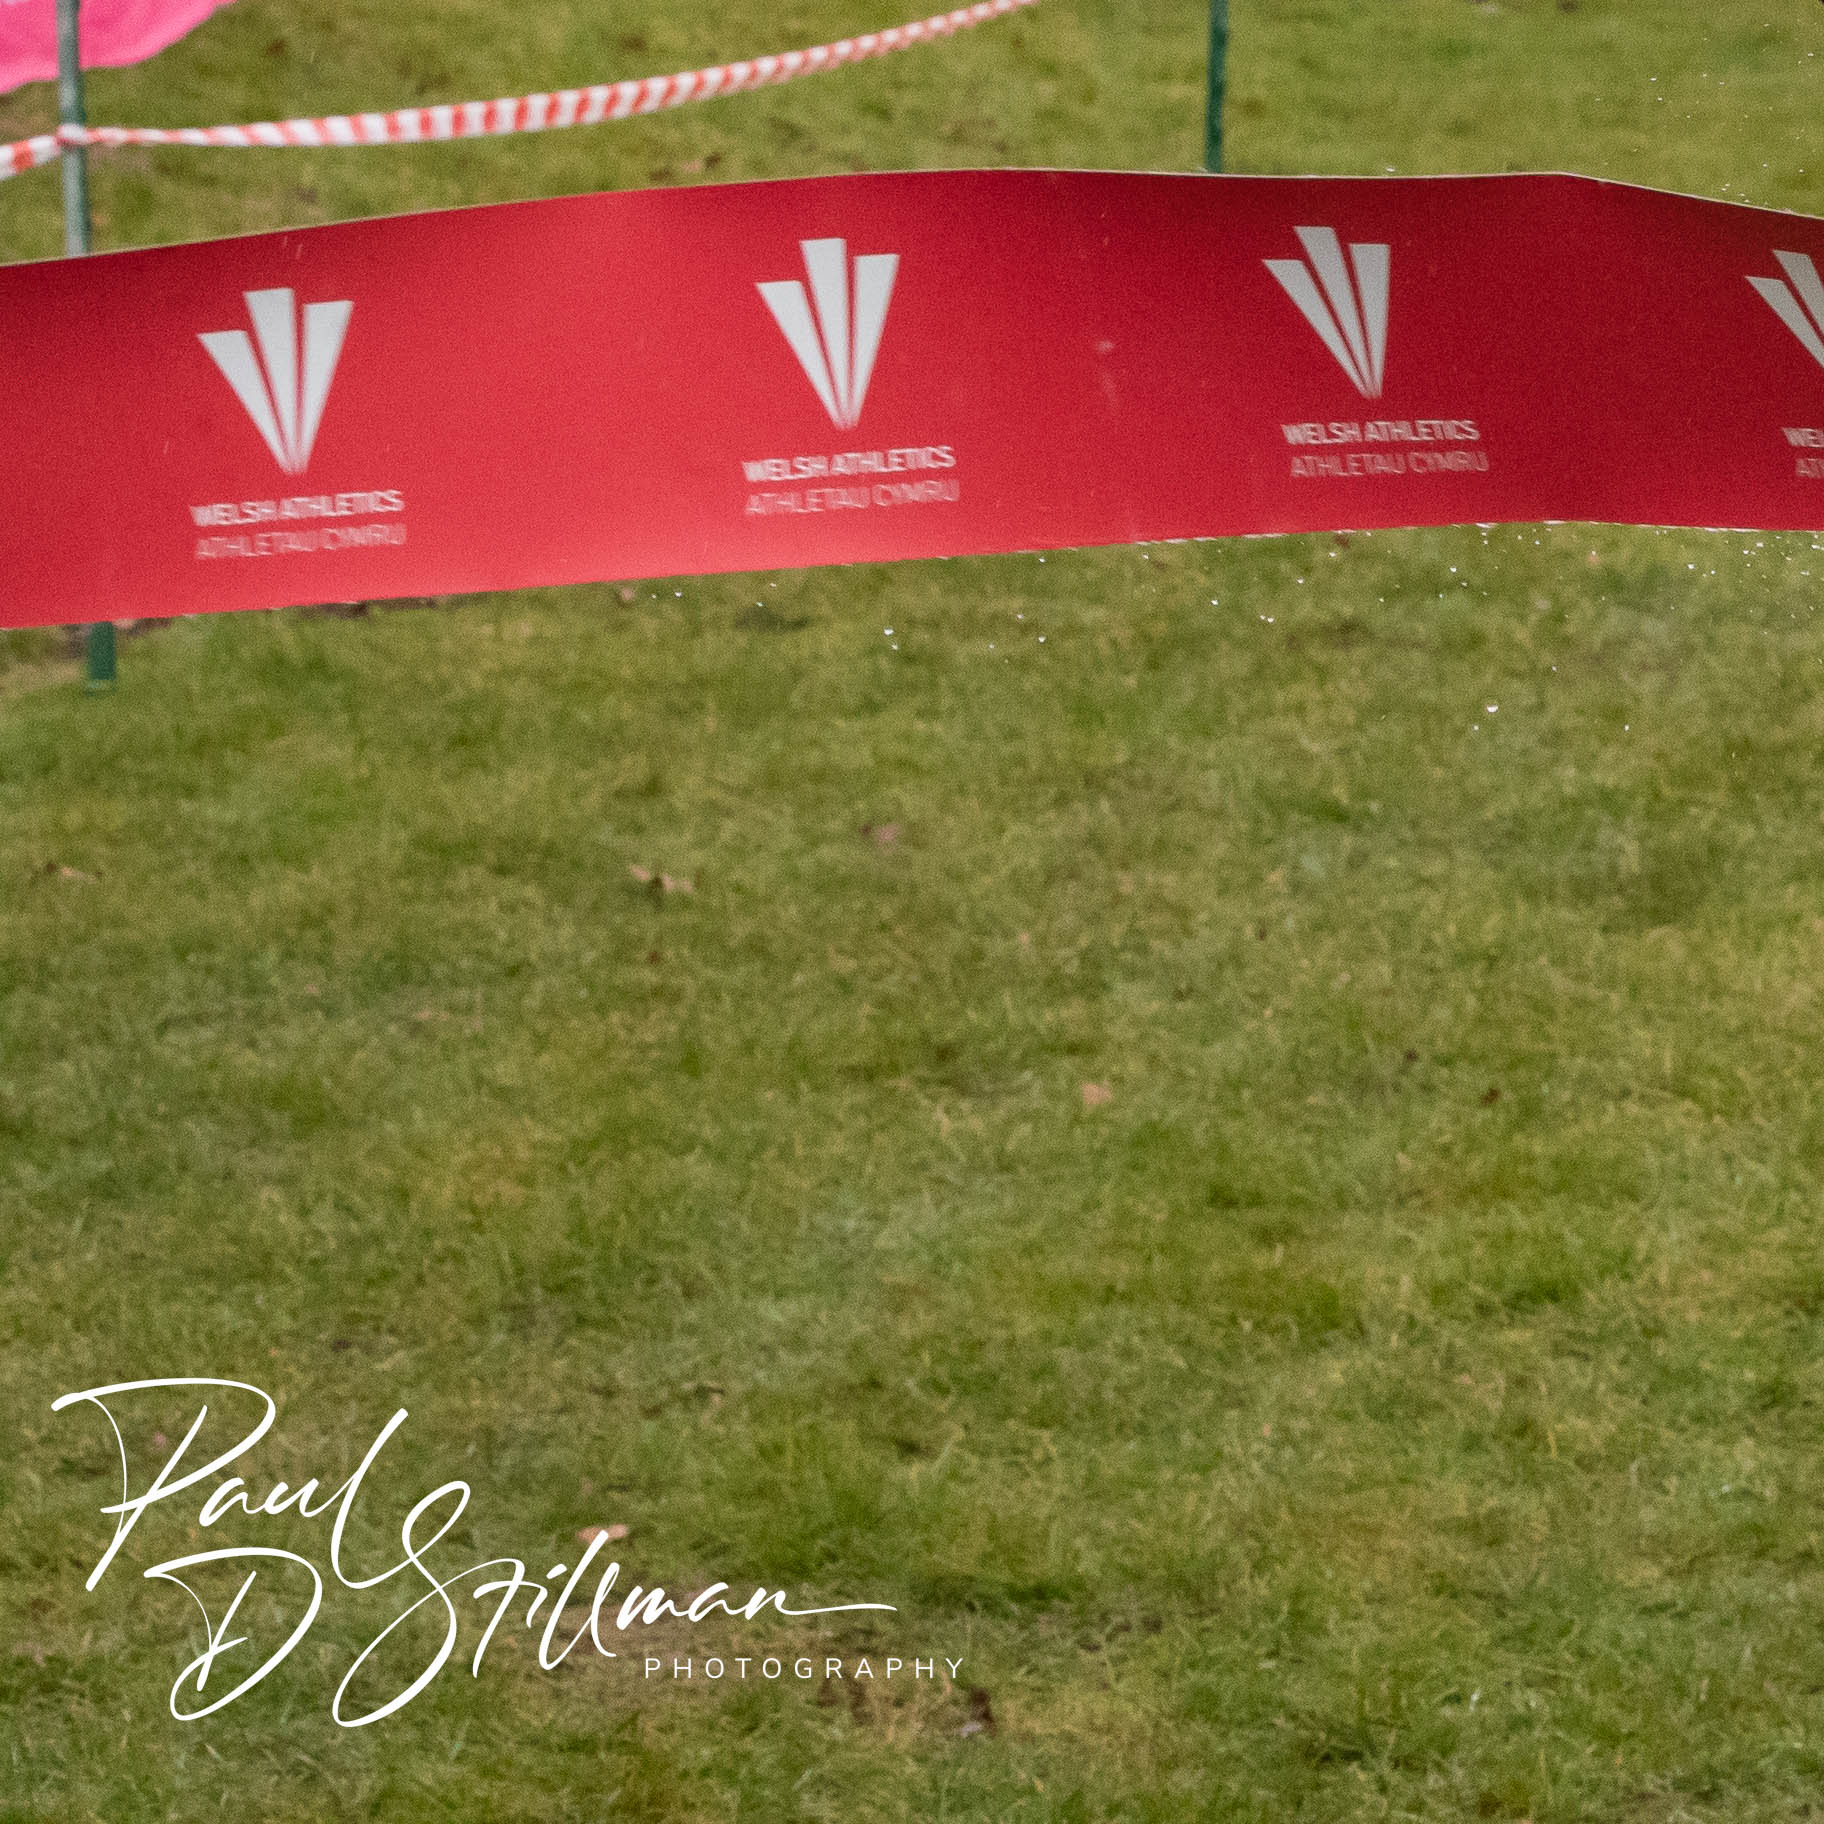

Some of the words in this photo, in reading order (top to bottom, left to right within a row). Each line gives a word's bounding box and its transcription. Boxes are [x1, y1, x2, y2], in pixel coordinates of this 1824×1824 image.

[1281, 420, 1361, 446] WELSH
[1363, 418, 1480, 443] ATHLETICS
[1290, 452, 1405, 478] ATHLETAU
[1412, 449, 1490, 475] CYMRU
